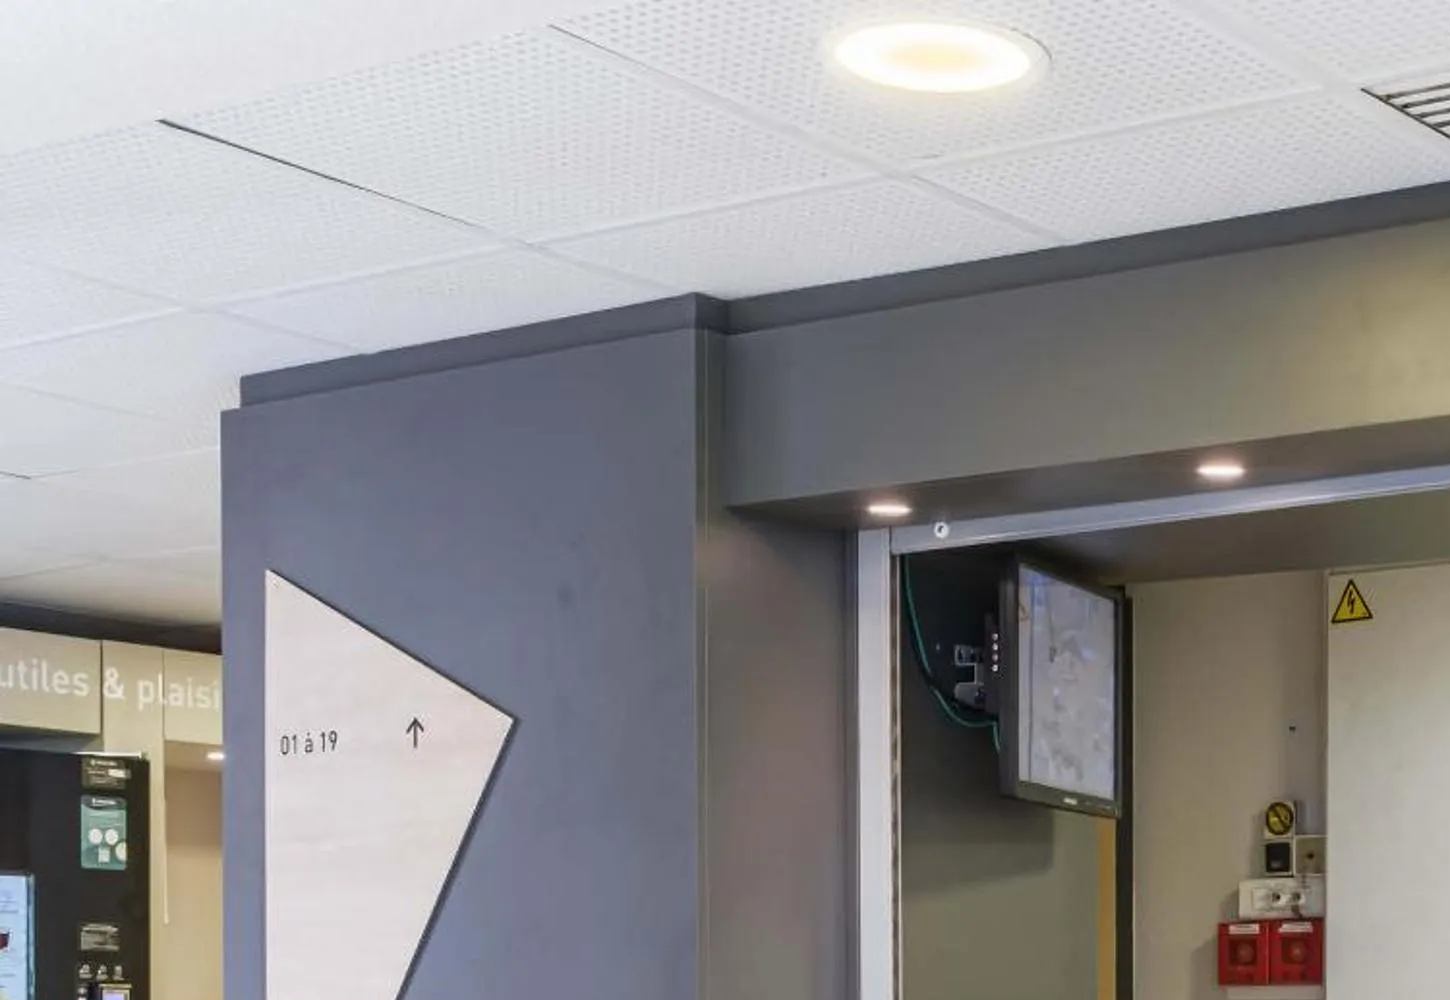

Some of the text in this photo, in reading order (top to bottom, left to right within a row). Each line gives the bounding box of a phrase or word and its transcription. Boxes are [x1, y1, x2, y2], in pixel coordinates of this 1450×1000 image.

[0, 658, 91, 697] utiles
[103, 667, 125, 699] &
[280, 730, 338, 756] 01 à 19
